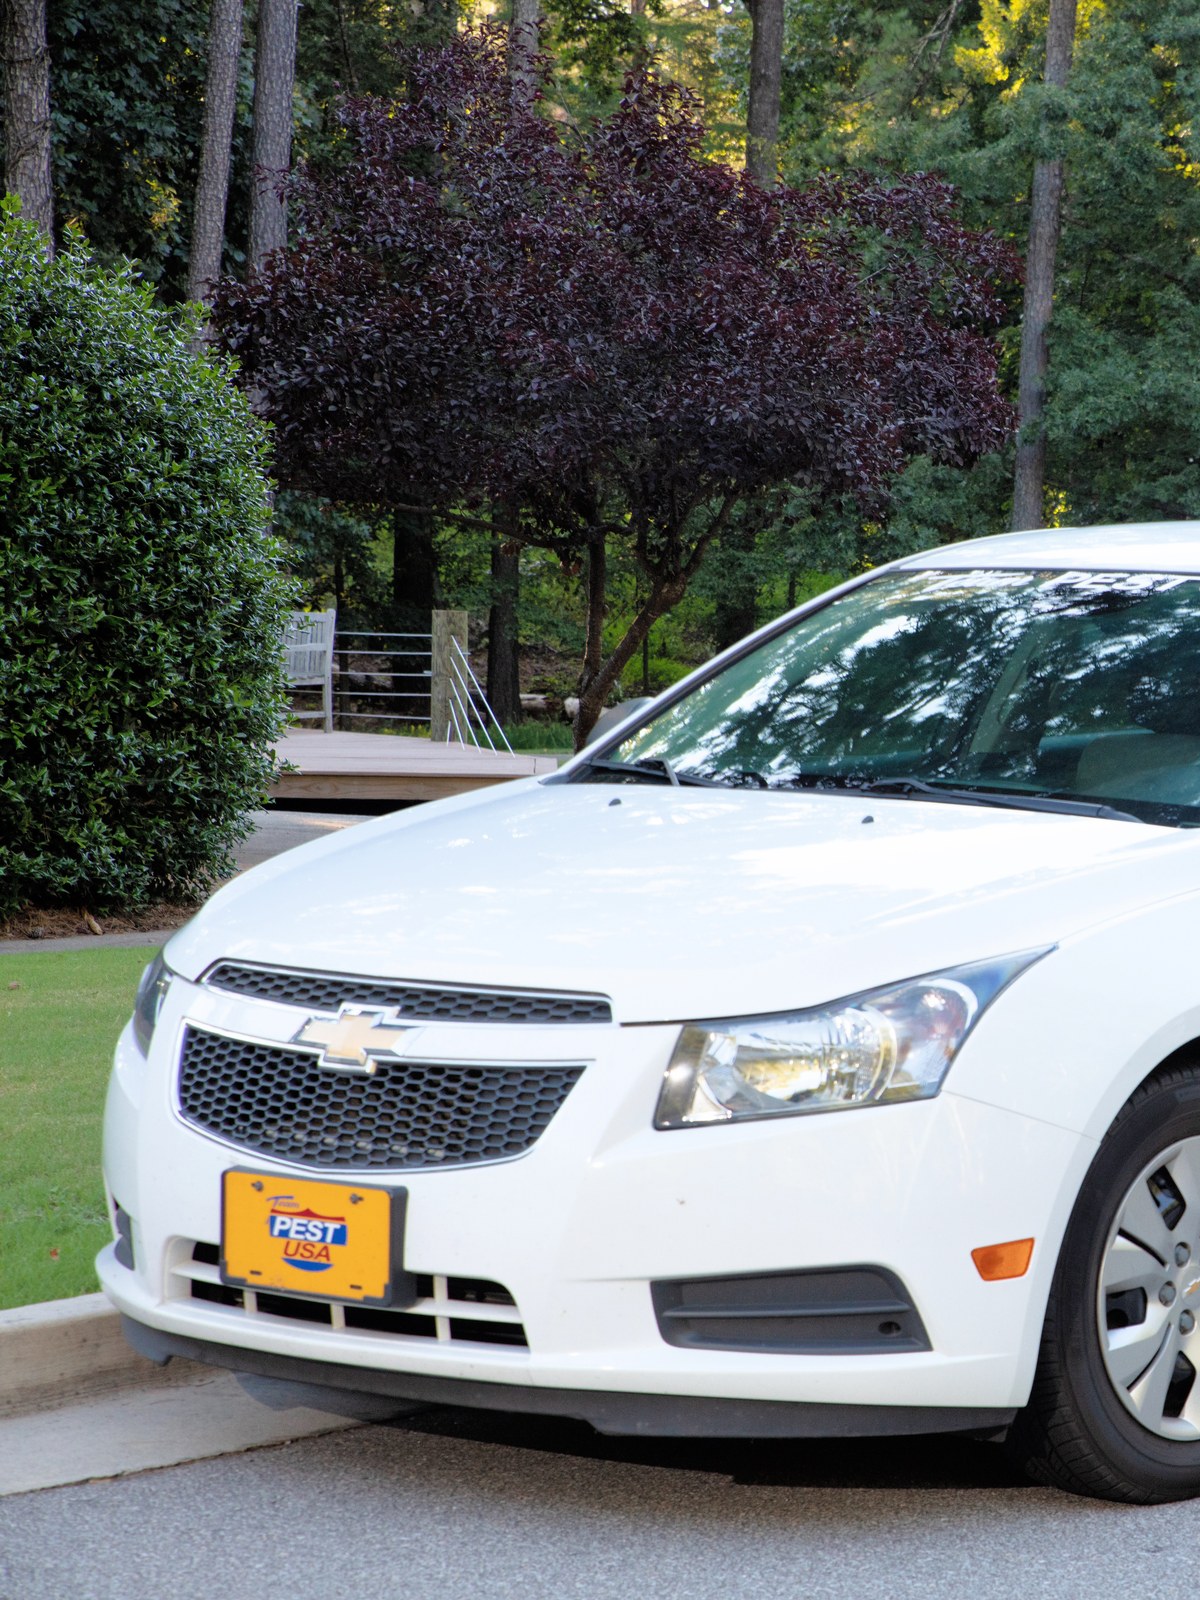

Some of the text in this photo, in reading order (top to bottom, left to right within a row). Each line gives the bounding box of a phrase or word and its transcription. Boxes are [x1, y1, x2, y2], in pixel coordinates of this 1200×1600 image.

[265, 1195, 300, 1209] Team
[272, 1215, 341, 1244] PEST
[283, 1240, 331, 1262] USA
